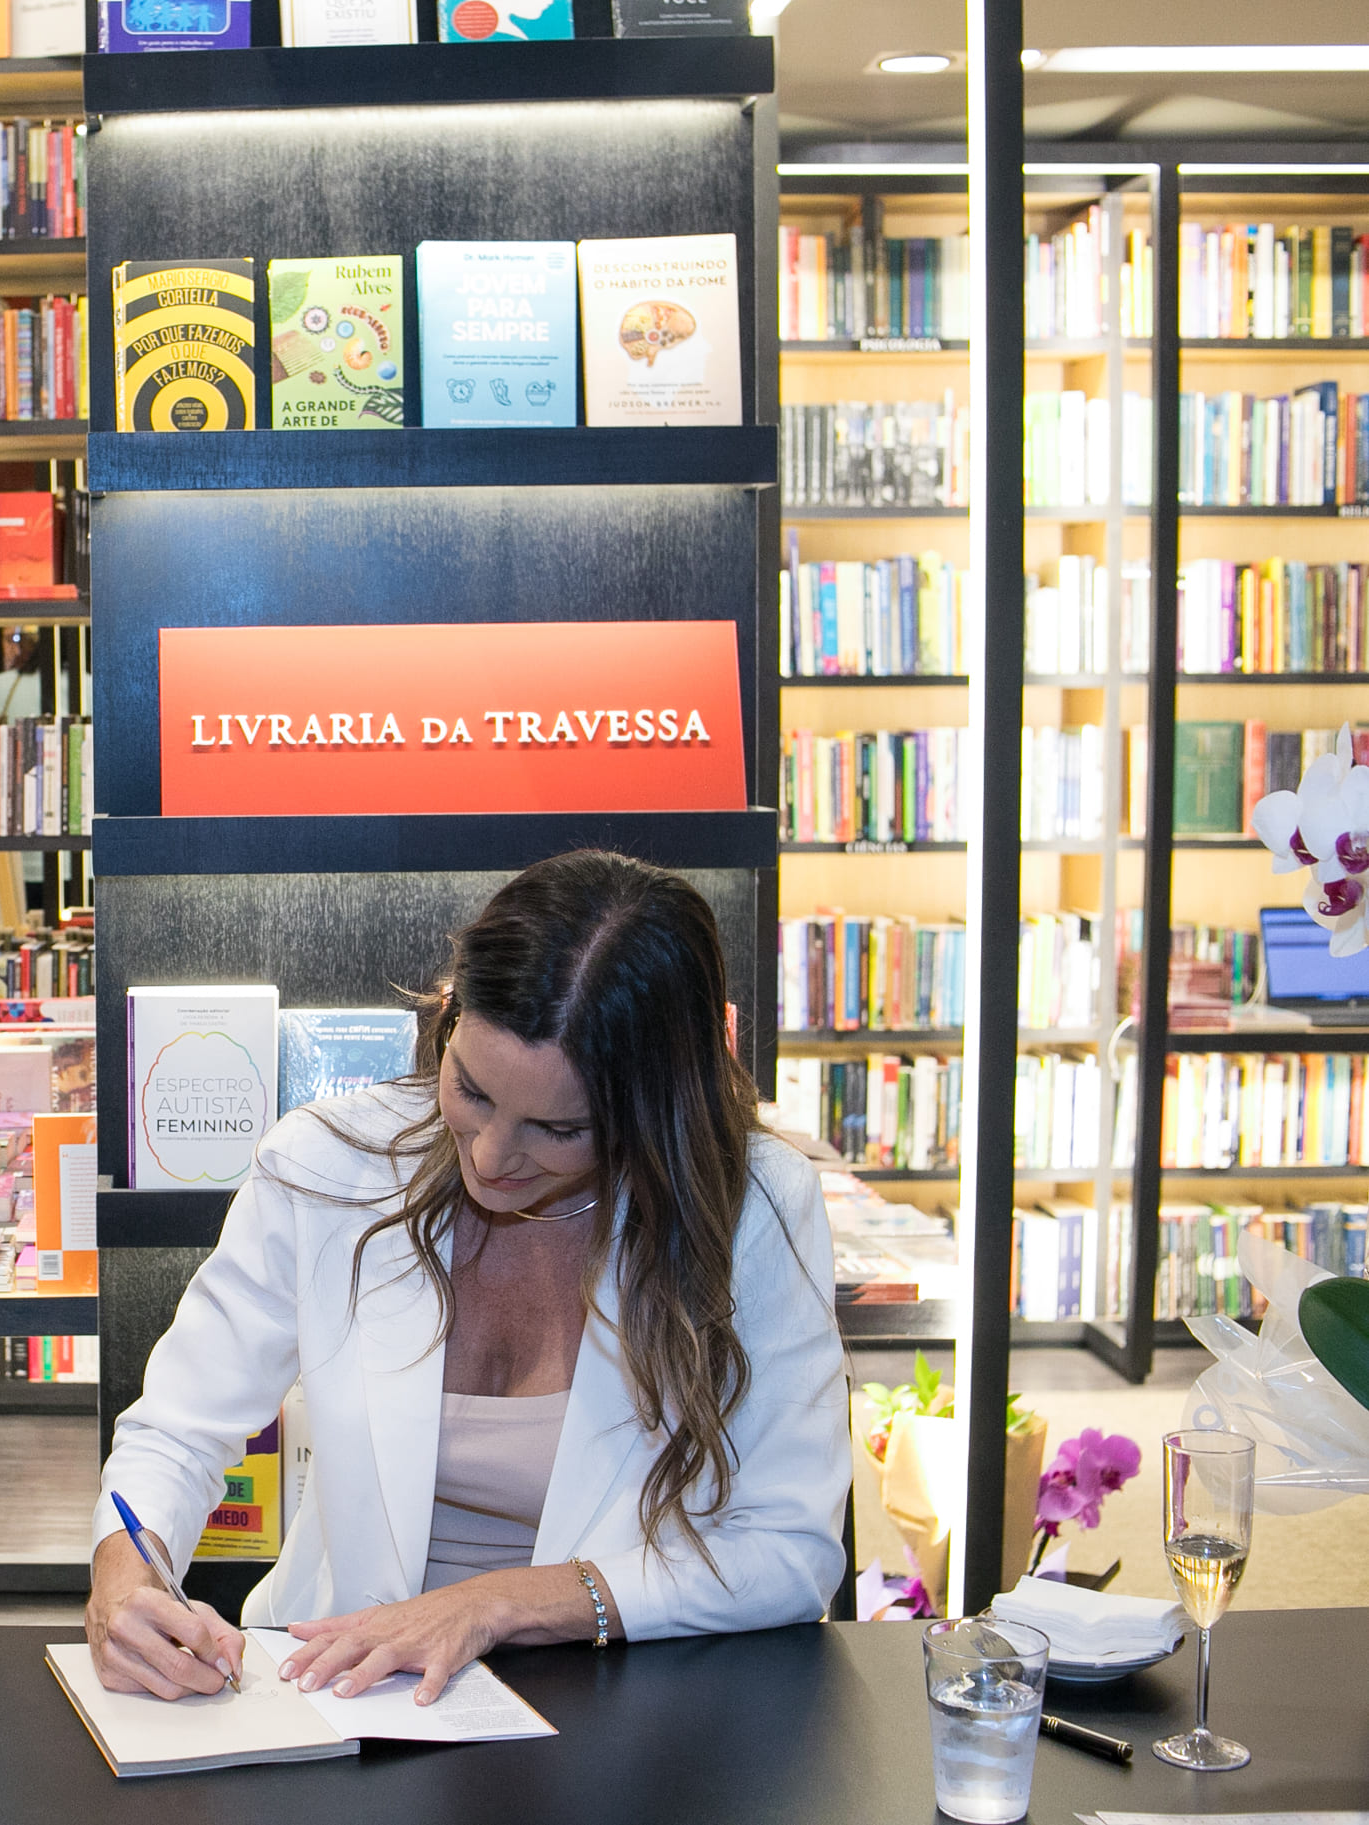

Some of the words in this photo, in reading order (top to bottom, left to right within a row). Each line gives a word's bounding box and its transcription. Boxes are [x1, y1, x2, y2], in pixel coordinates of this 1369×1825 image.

[336, 264, 392, 279] Rubem
[593, 259, 728, 274] DESCONSTRUINDO
[187, 271, 229, 289] SERGIO
[351, 281, 392, 295] Alves
[455, 273, 546, 296] JOVEM
[594, 279, 605, 290] O
[666, 277, 685, 288] DA
[689, 275, 728, 287] FOME
[158, 289, 219, 307] CORTELLA
[467, 297, 533, 319] PARA
[133, 333, 161, 356] POR
[160, 326, 185, 342] QUE
[187, 325, 246, 355] FAZEMOS
[451, 321, 550, 343] SEMPRE
[170, 346, 180, 361] O
[183, 344, 208, 359] QUE
[152, 362, 226, 387] FAZEMOS?
[282, 402, 292, 412] A
[296, 401, 356, 412] GRANDE
[609, 400, 651, 409] JUDSON
[282, 416, 317, 427] ARTE
[321, 416, 338, 426] DE
[191, 713, 406, 747] LIVRARIA
[421, 717, 474, 745] DA
[484, 709, 711, 744] TRAVESSA
[156, 1078, 253, 1092] ESPECTRO
[157, 1097, 253, 1114] AUTISTA
[157, 1119, 253, 1133] FEMININO
